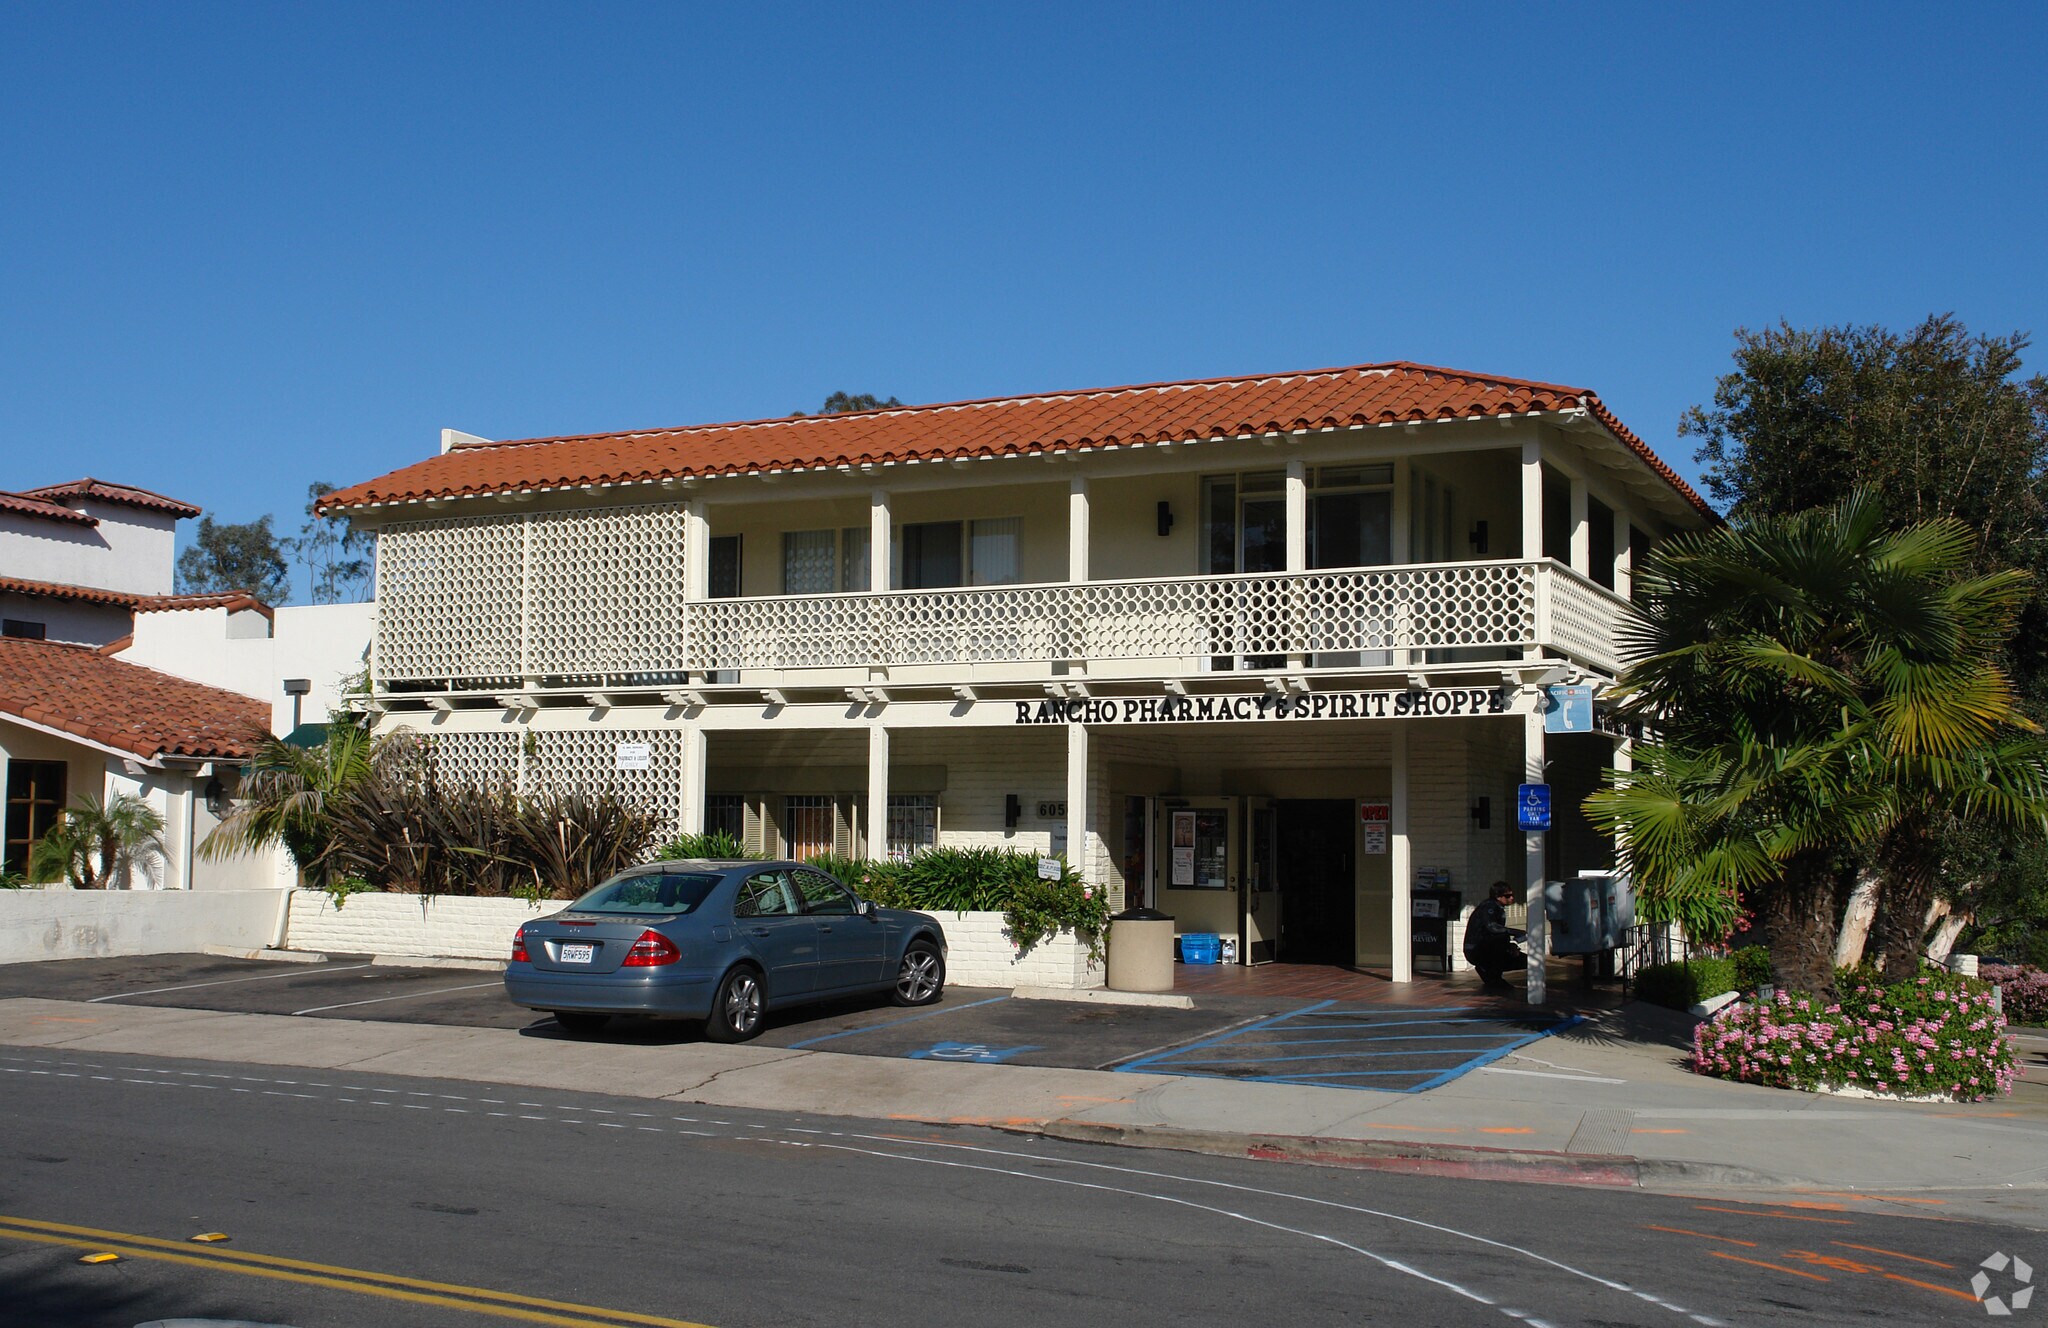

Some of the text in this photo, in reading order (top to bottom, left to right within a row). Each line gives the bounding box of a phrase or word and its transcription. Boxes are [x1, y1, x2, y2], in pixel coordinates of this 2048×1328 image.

[1016, 688, 1505, 724] RANCHO PHARMACY & SPIRIT SHOPPE
[1361, 805, 1389, 821] OPEN
[563, 949, 590, 961] 5RWF595
